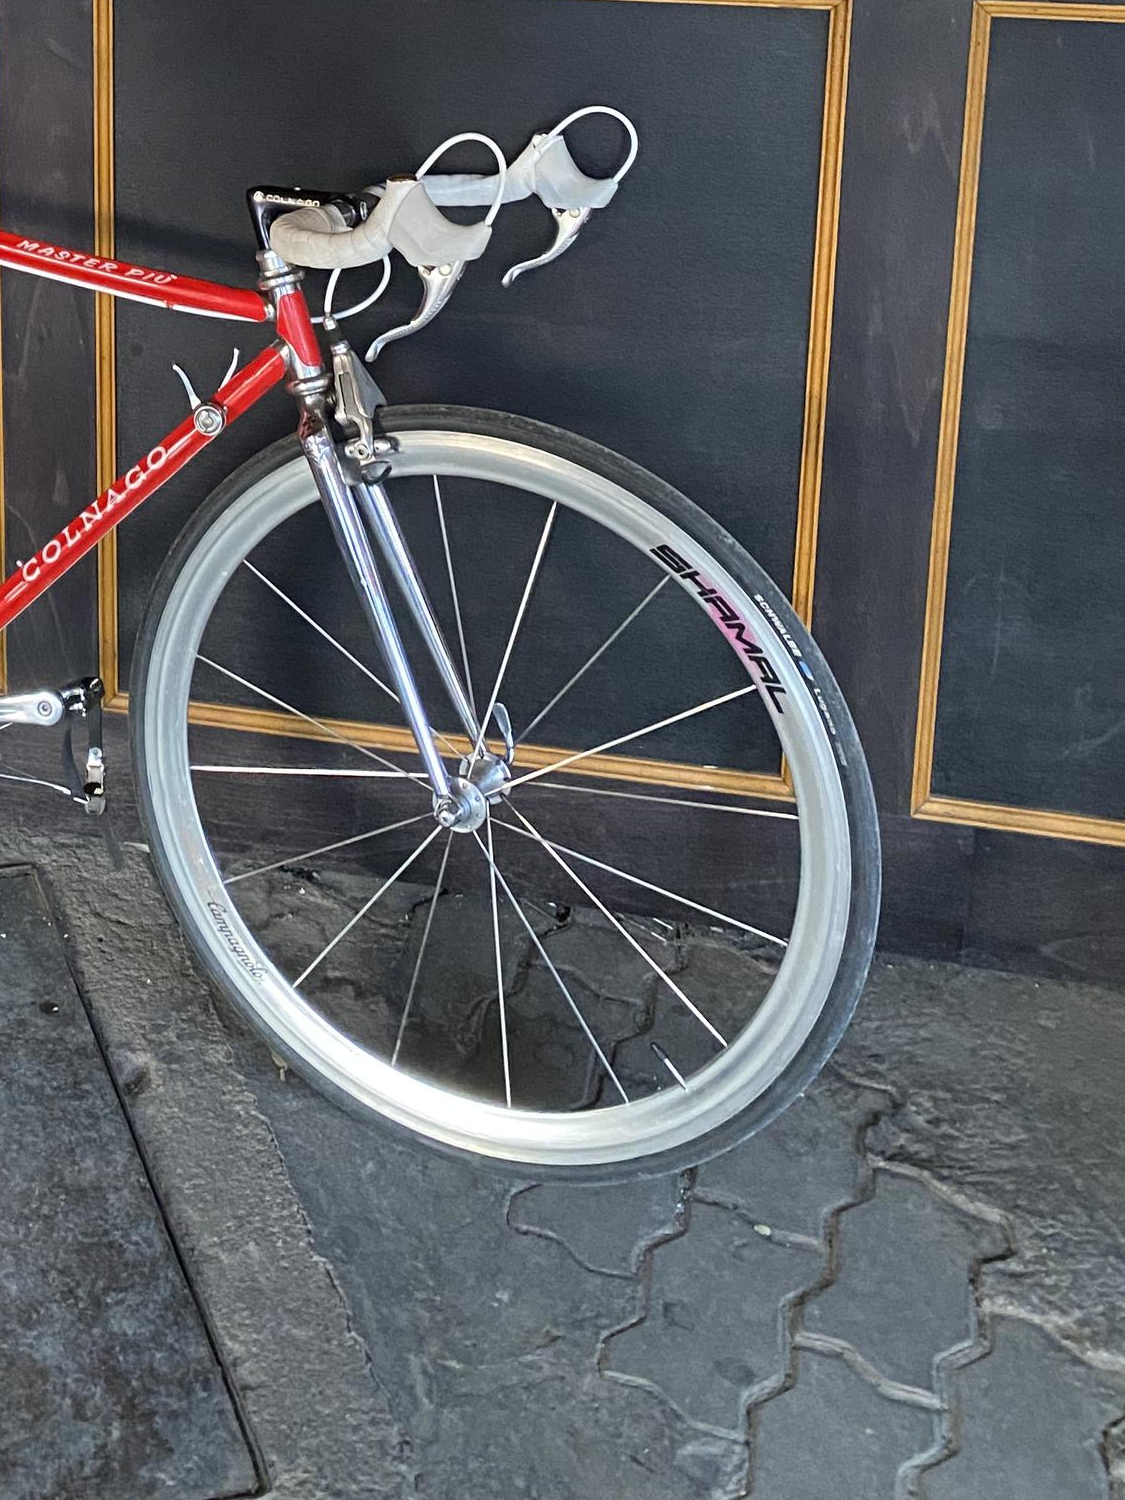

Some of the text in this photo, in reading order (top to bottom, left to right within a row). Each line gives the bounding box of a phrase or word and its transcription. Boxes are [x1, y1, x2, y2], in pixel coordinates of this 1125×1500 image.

[17, 239, 118, 273] MASTER
[22, 445, 169, 582] COLNAGO
[651, 544, 787, 715] SHAMAL
[753, 594, 803, 658] SCHWALBE
